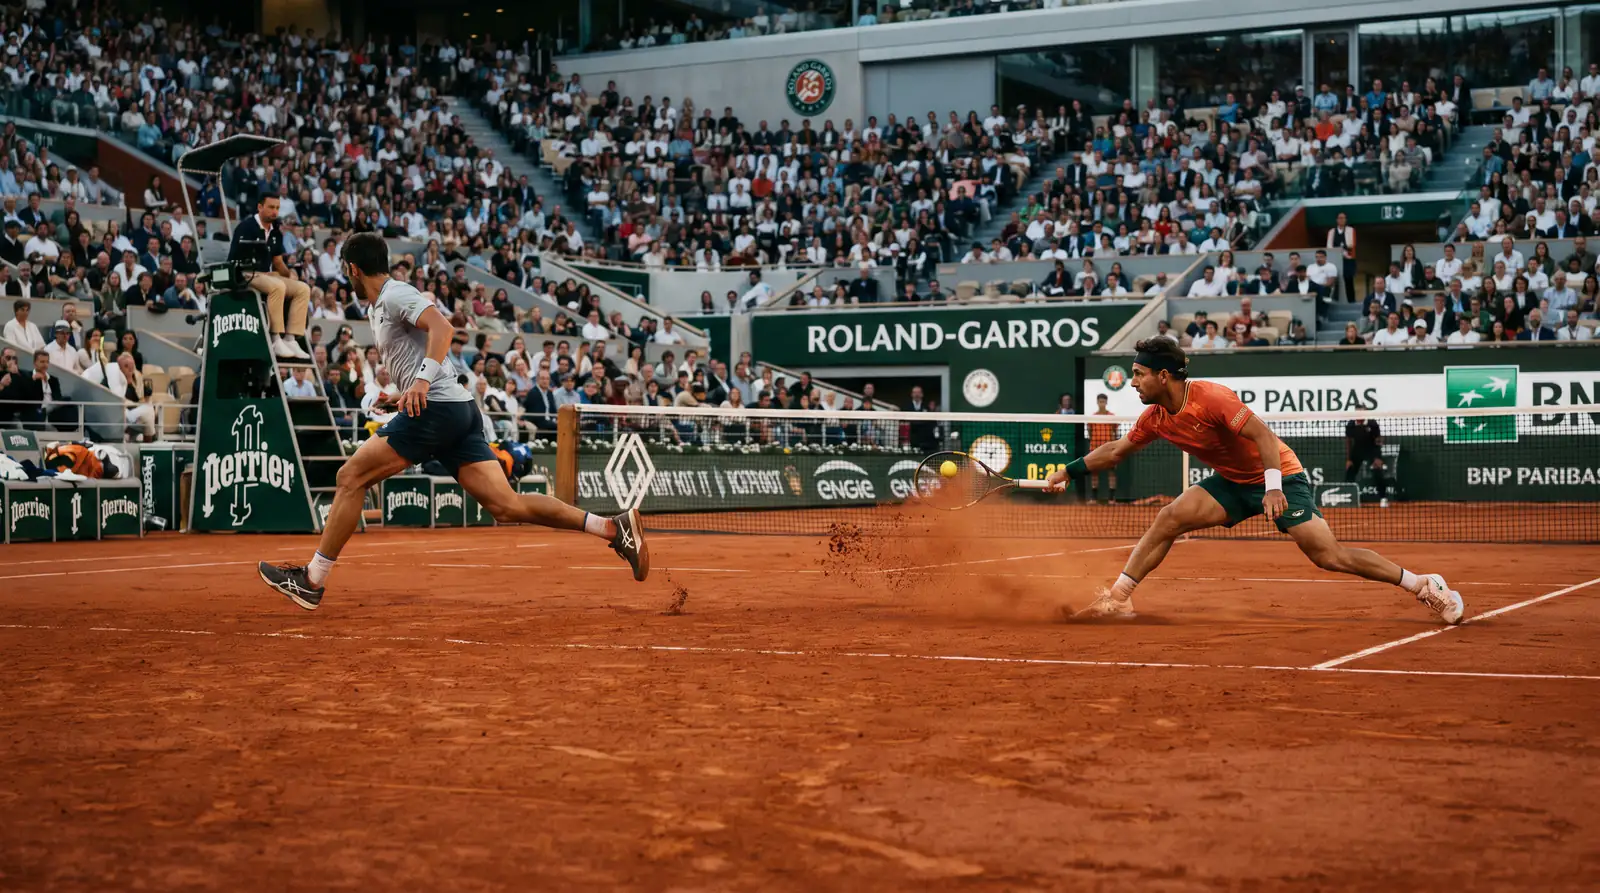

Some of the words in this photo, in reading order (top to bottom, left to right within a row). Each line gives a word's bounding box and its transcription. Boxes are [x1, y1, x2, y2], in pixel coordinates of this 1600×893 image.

[212, 307, 260, 348] perrier
[807, 317, 1100, 353] ROLAND-GARROS
[1264, 387, 1378, 413] PARIBAS
[1025, 443, 1068, 454] ROLEX
[202, 441, 295, 518] perrier
[1467, 467, 1512, 485] BNP
[1517, 467, 1600, 485] PARIBA
[11, 496, 51, 533] perrier
[101, 495, 138, 529] perrier
[386, 487, 429, 521] perrier
[435, 489, 463, 519] perrier
